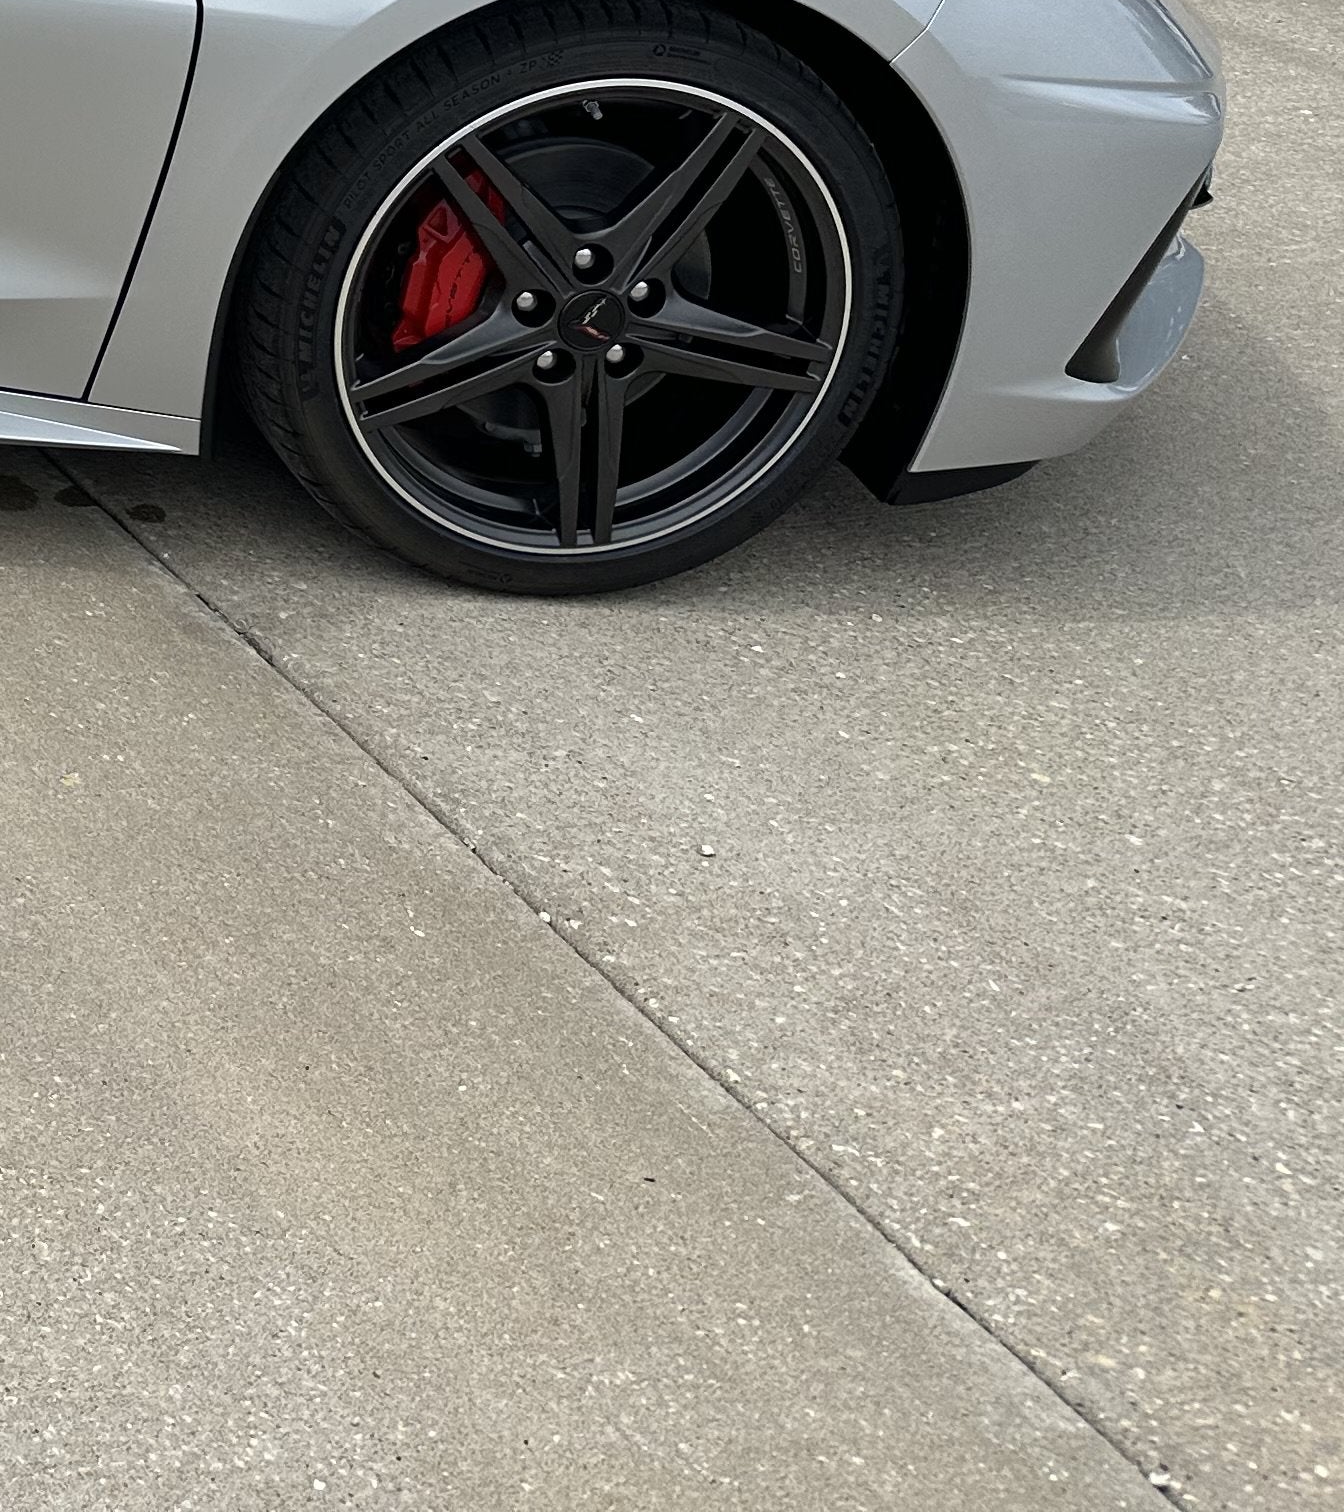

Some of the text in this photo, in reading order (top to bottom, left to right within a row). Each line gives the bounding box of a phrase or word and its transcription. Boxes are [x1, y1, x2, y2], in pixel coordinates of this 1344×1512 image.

[343, 171, 371, 209] PILOT
[374, 132, 411, 169] SPORT
[416, 111, 440, 132] ALL
[443, 74, 501, 111] SEASON
[519, 59, 538, 74] ZP
[763, 176, 802, 273] CORVETTE
[298, 224, 340, 362] MICHELIN
[843, 284, 889, 418] MICHELIN
